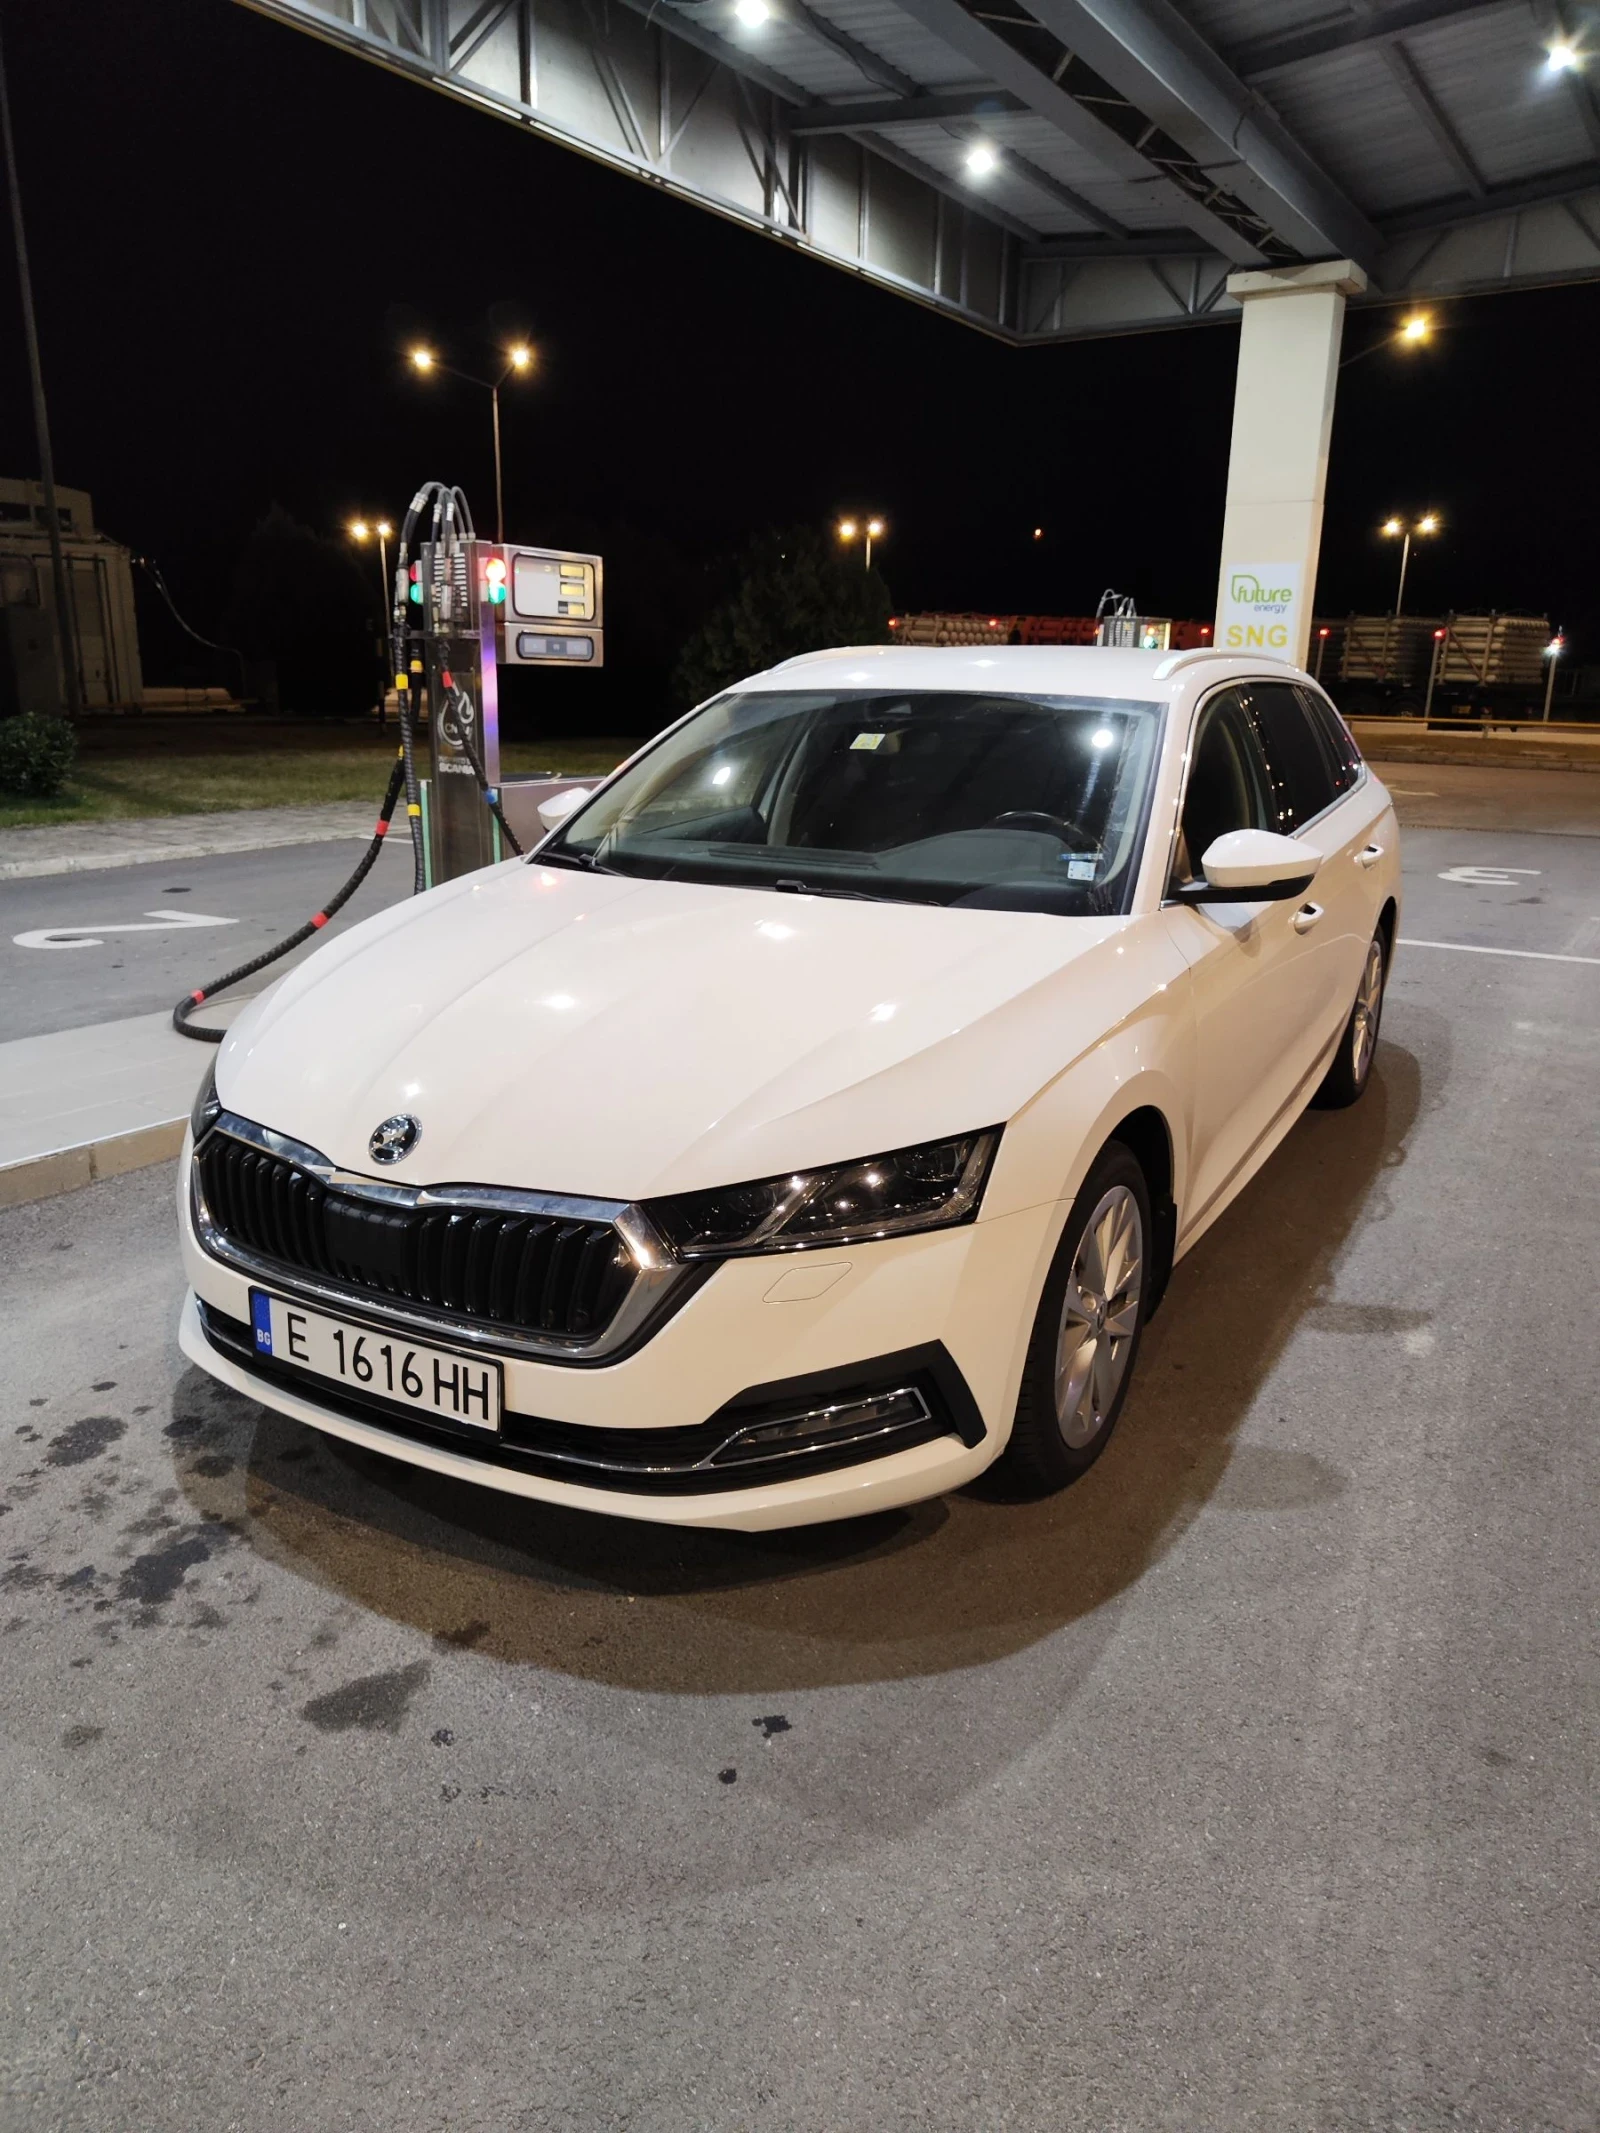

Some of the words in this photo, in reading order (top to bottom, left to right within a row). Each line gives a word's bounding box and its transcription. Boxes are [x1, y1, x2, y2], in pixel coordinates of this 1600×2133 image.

[1233, 579, 1292, 603] future
[1253, 604, 1287, 614] energy
[1226, 624, 1288, 648] SNG
[256, 1328, 271, 1346] BG
[287, 1311, 310, 1362] E
